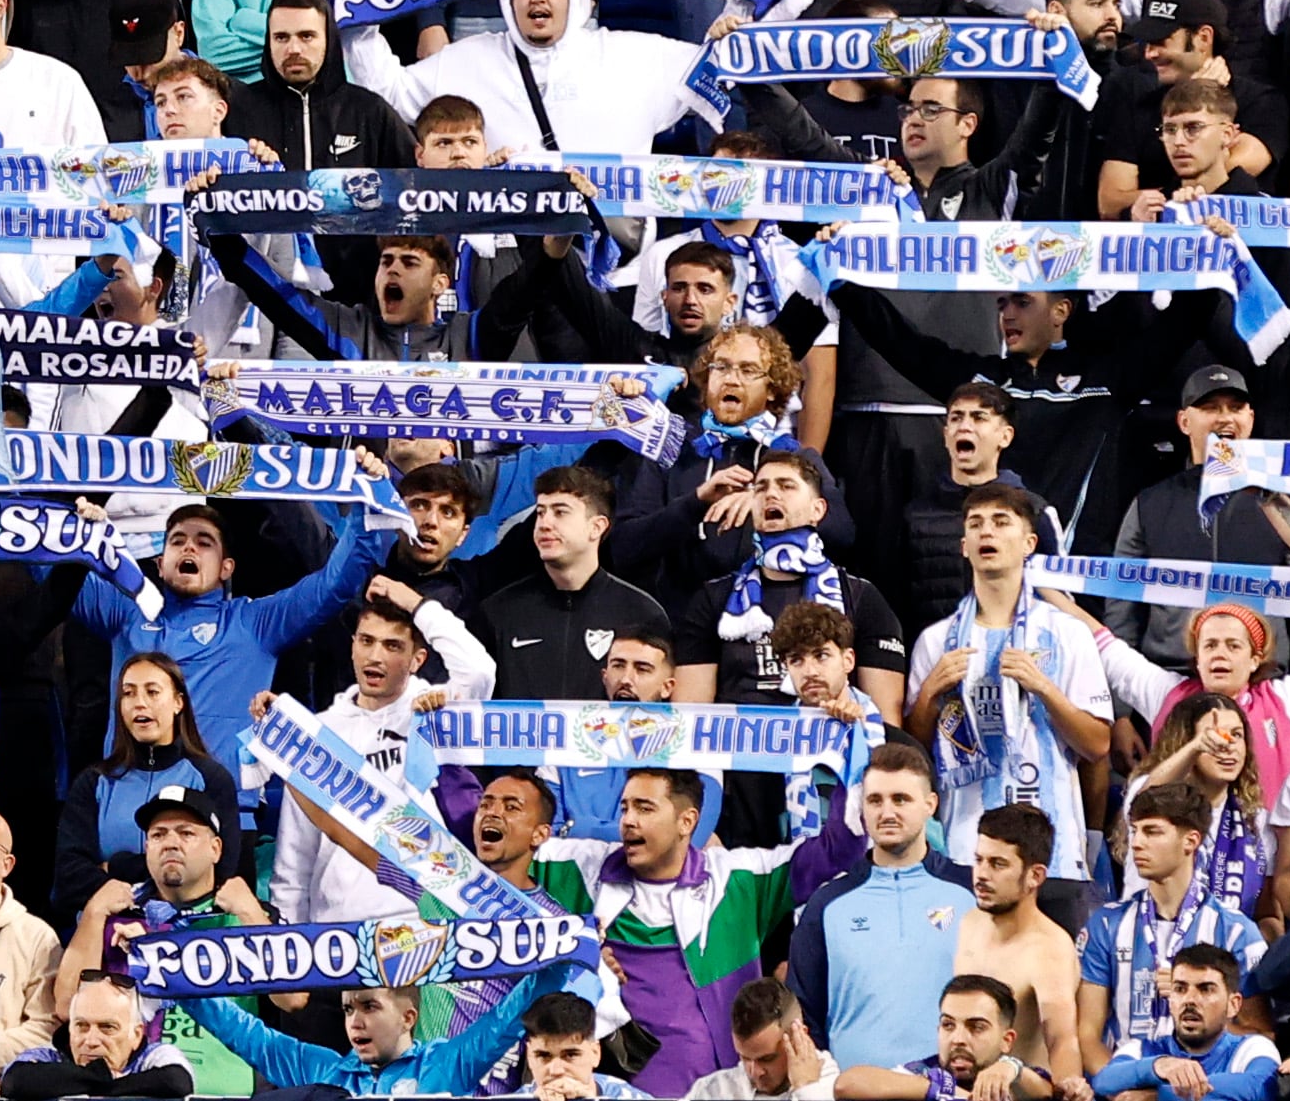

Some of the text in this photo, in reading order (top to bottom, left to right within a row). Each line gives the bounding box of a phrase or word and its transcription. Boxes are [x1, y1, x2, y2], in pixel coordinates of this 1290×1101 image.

[1149, 1, 1179, 17] EA7
[718, 28, 872, 75] ONDO
[397, 188, 457, 214] CON
[466, 186, 529, 215] MÁS
[40, 352, 200, 387] ROSALEDA
[257, 380, 574, 422] MALAGA C.F.
[306, 423, 525, 442] CLUB DE FUTBOL
[144, 915, 581, 987] FONDO SUR
